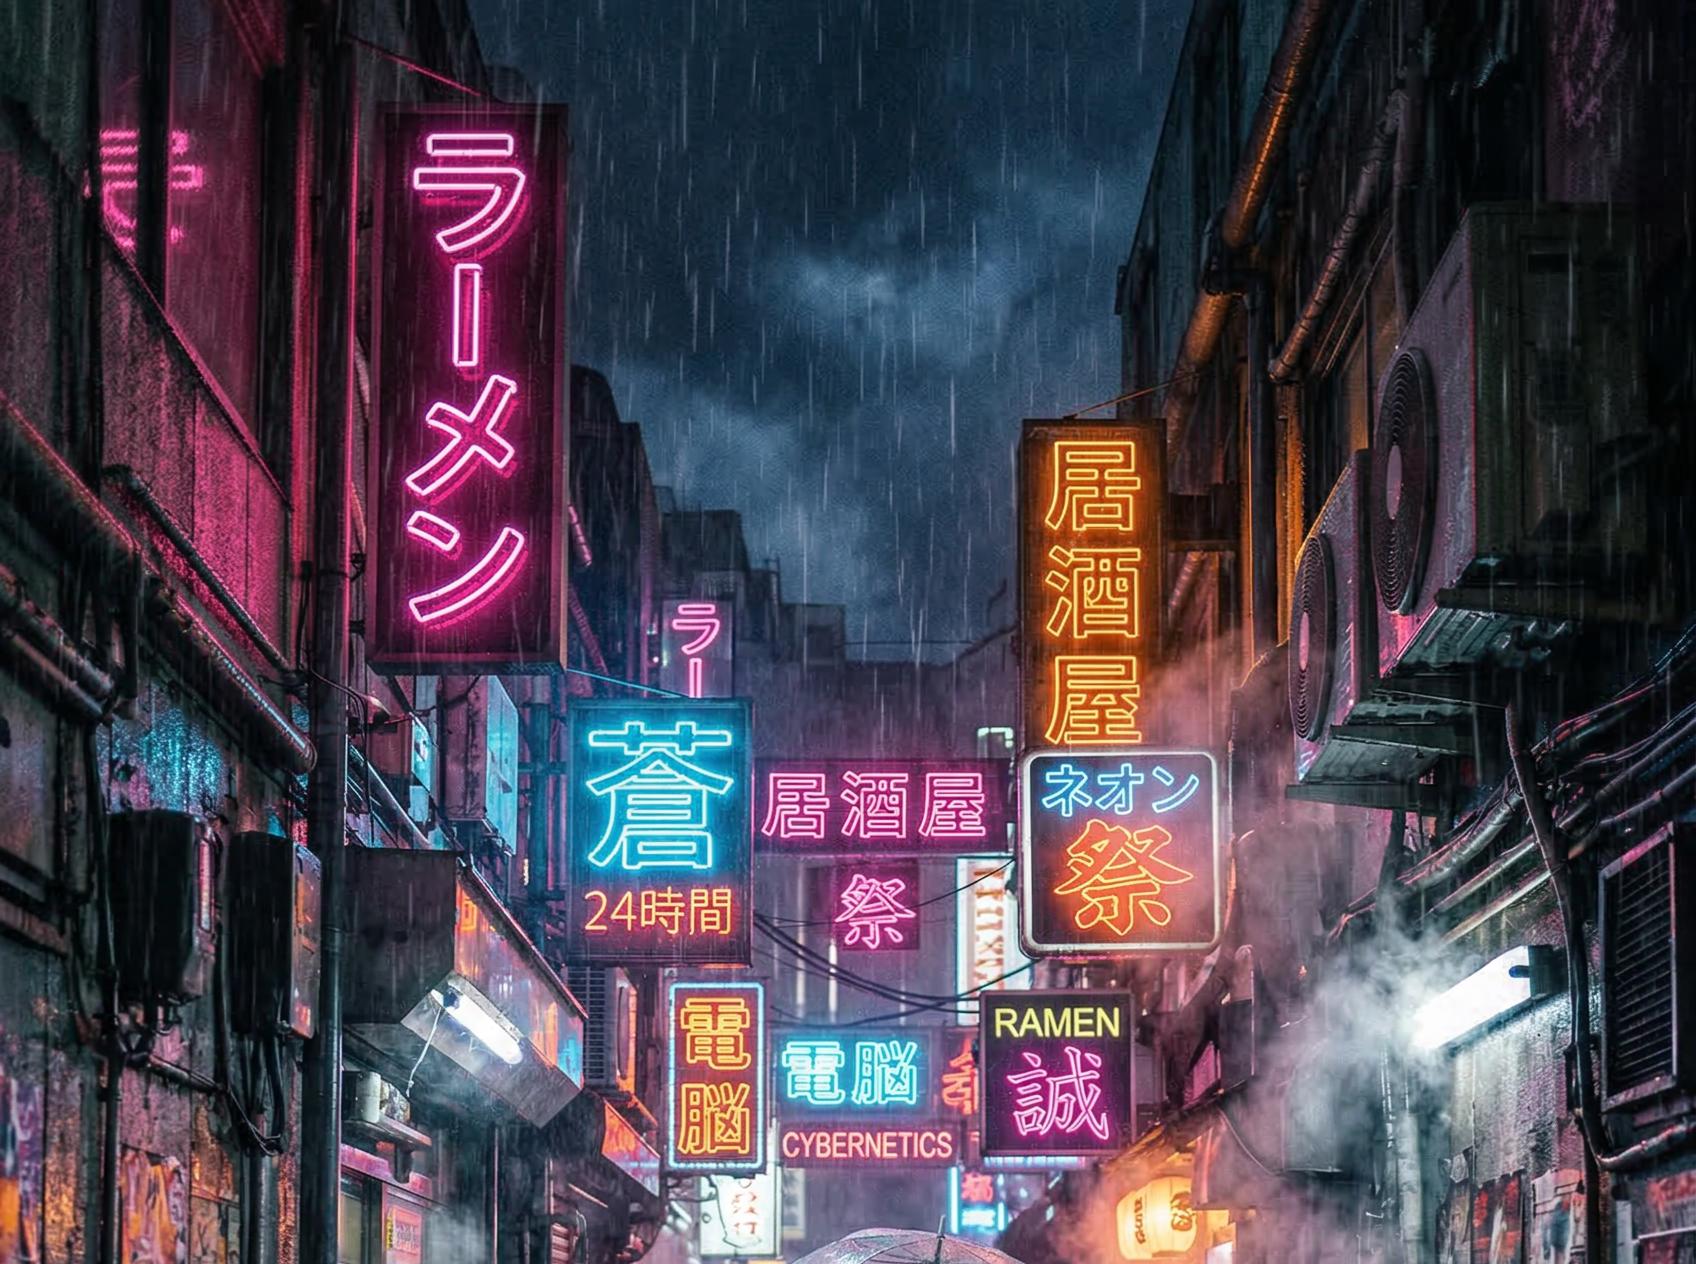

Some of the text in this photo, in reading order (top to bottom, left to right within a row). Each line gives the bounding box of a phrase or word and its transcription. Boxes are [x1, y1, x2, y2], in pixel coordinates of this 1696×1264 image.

[405, 133, 526, 623] ラーメン
[1045, 441, 1142, 745] 居酒屋
[586, 721, 734, 870] 蒼
[761, 771, 987, 839] 居酒屋
[1042, 763, 1200, 817] ネオン
[583, 885, 732, 936] 24時間
[835, 873, 916, 949] 祭
[1054, 818, 1194, 936] 祭
[994, 1007, 1120, 1038] RAMEN
[678, 998, 750, 1155] 電脳
[782, 1040, 917, 1105] 電脳
[1006, 1046, 1109, 1140] 誠
[782, 1131, 953, 1158] CYBERNETICS
